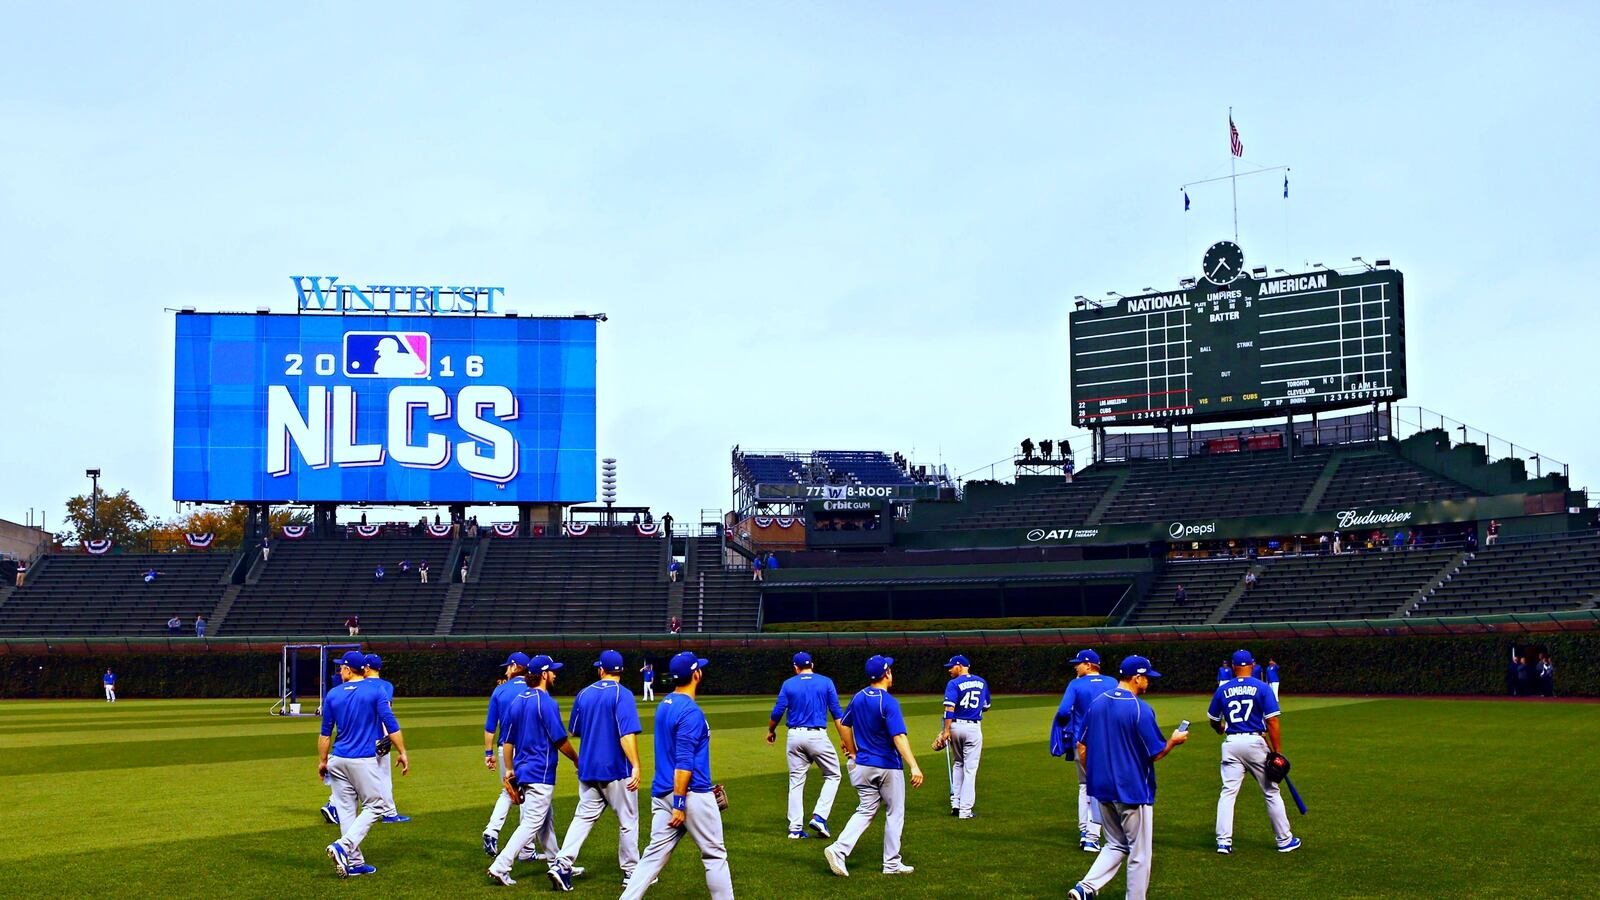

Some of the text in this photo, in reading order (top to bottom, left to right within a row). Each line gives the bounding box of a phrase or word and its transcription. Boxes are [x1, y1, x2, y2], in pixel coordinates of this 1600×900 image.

[1258, 275, 1327, 296] AMERICAN
[289, 276, 505, 314] WINTRUST
[1207, 290, 1242, 301] UMPIRES
[1127, 293, 1190, 313] NATIONAL
[1209, 311, 1240, 323] BATTER
[1287, 380, 1310, 388] TORONTO
[1287, 388, 1315, 396] CLEVELAND
[267, 385, 519, 484] NLCS
[828, 488, 842, 498] W
[824, 500, 852, 511] Orbit
[1337, 509, 1411, 528] Budweiser
[1044, 529, 1073, 540] ATI
[1186, 523, 1215, 536] pepsi
[1224, 686, 1257, 698] LOMBARD
[960, 691, 980, 708] 45
[1228, 699, 1253, 723] 27
